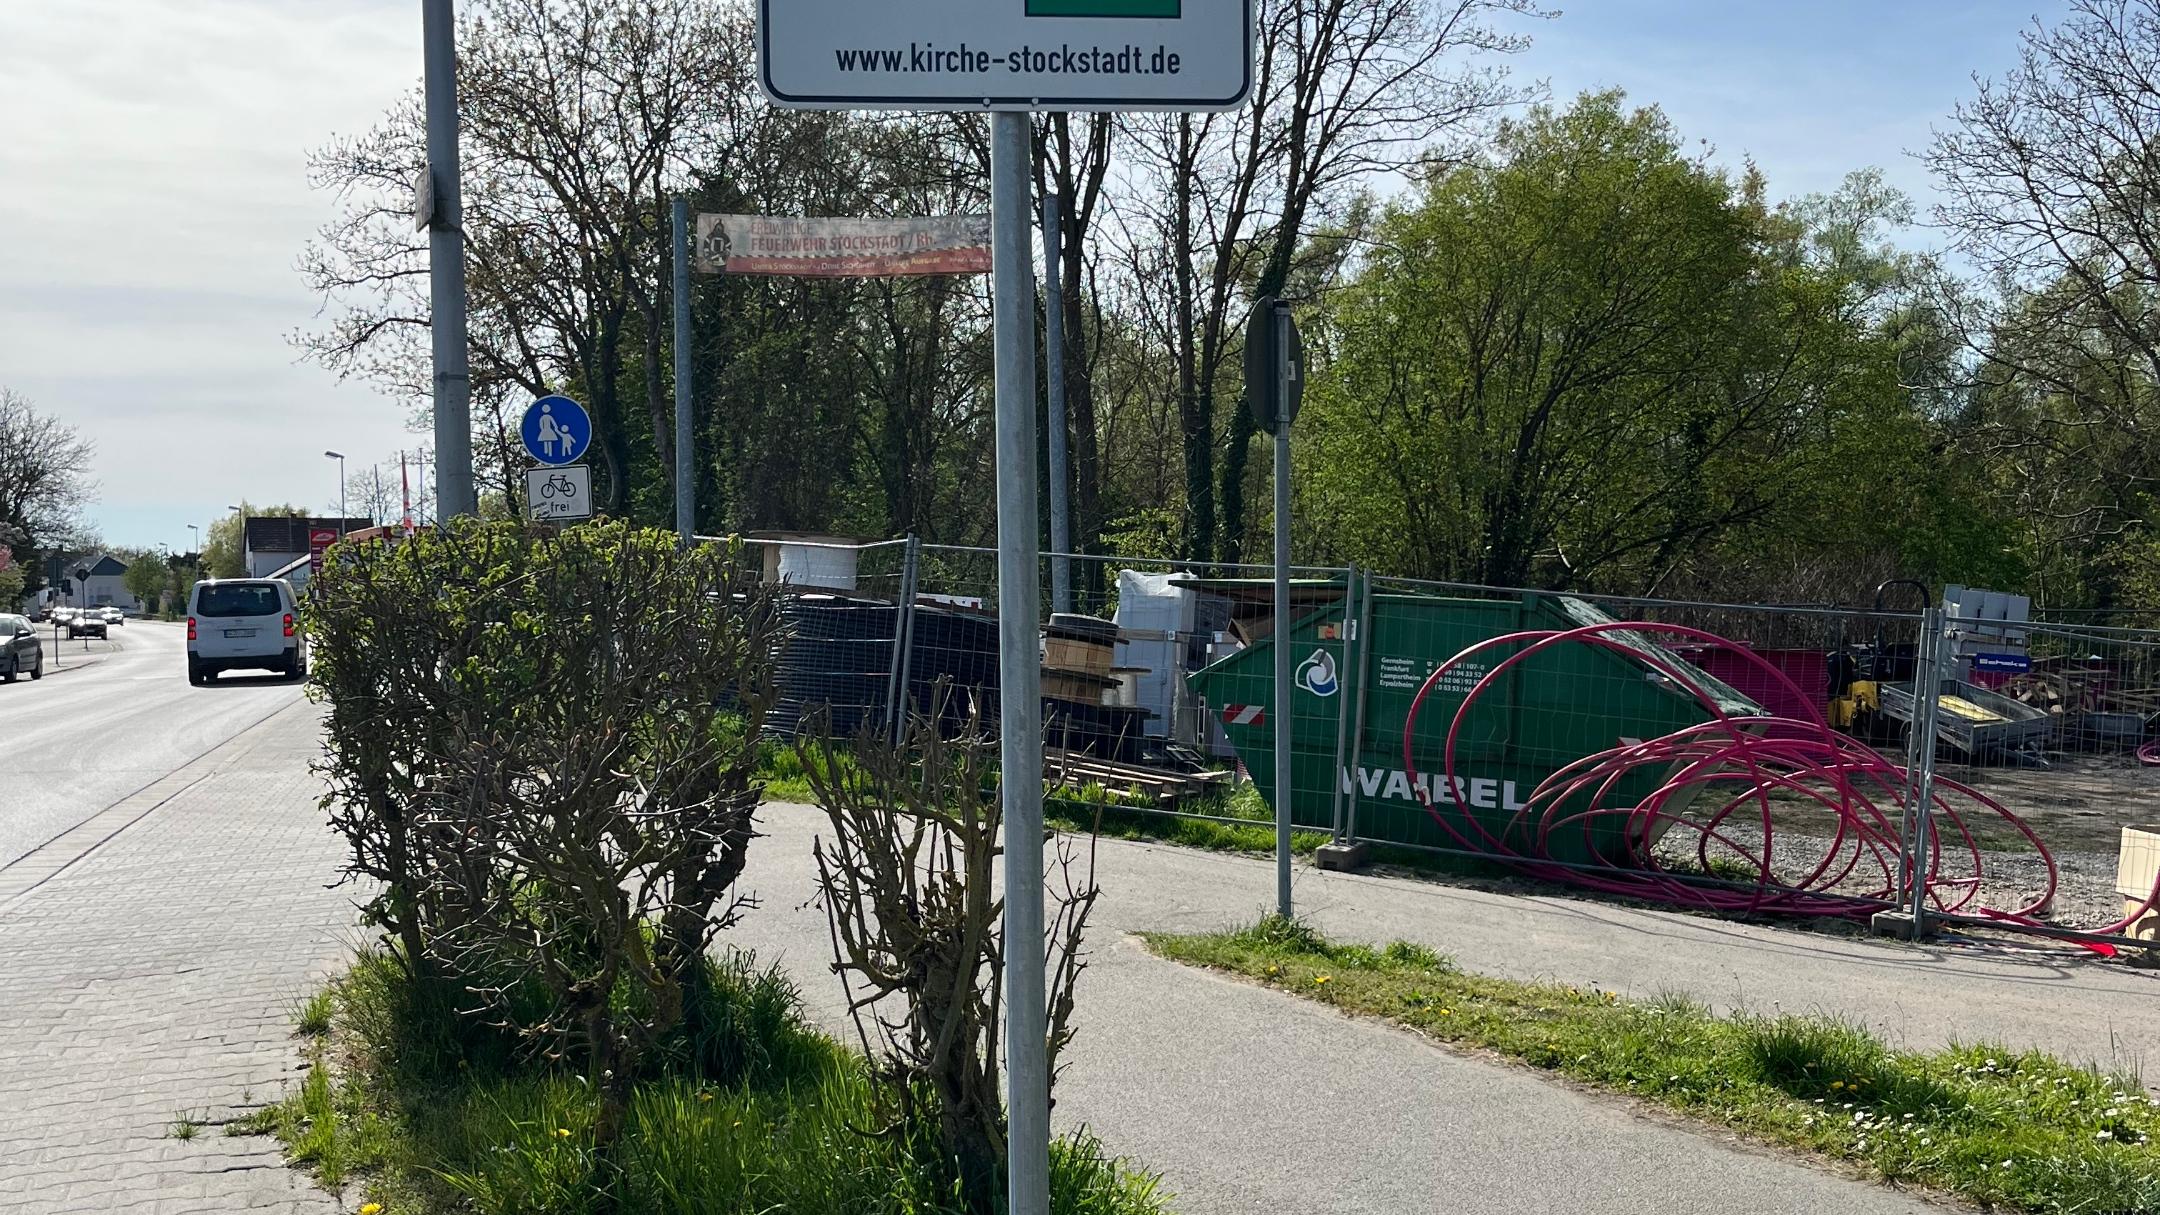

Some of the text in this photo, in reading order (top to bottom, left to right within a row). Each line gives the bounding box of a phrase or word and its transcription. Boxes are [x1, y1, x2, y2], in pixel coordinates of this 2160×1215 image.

[835, 43, 1181, 75] www.kirche-stockstadt.de
[751, 236, 826, 252] FEUERWEHR
[830, 232, 905, 251] STOCKSTADT
[550, 501, 570, 513] frei
[1380, 665, 1410, 673] Frankfurt
